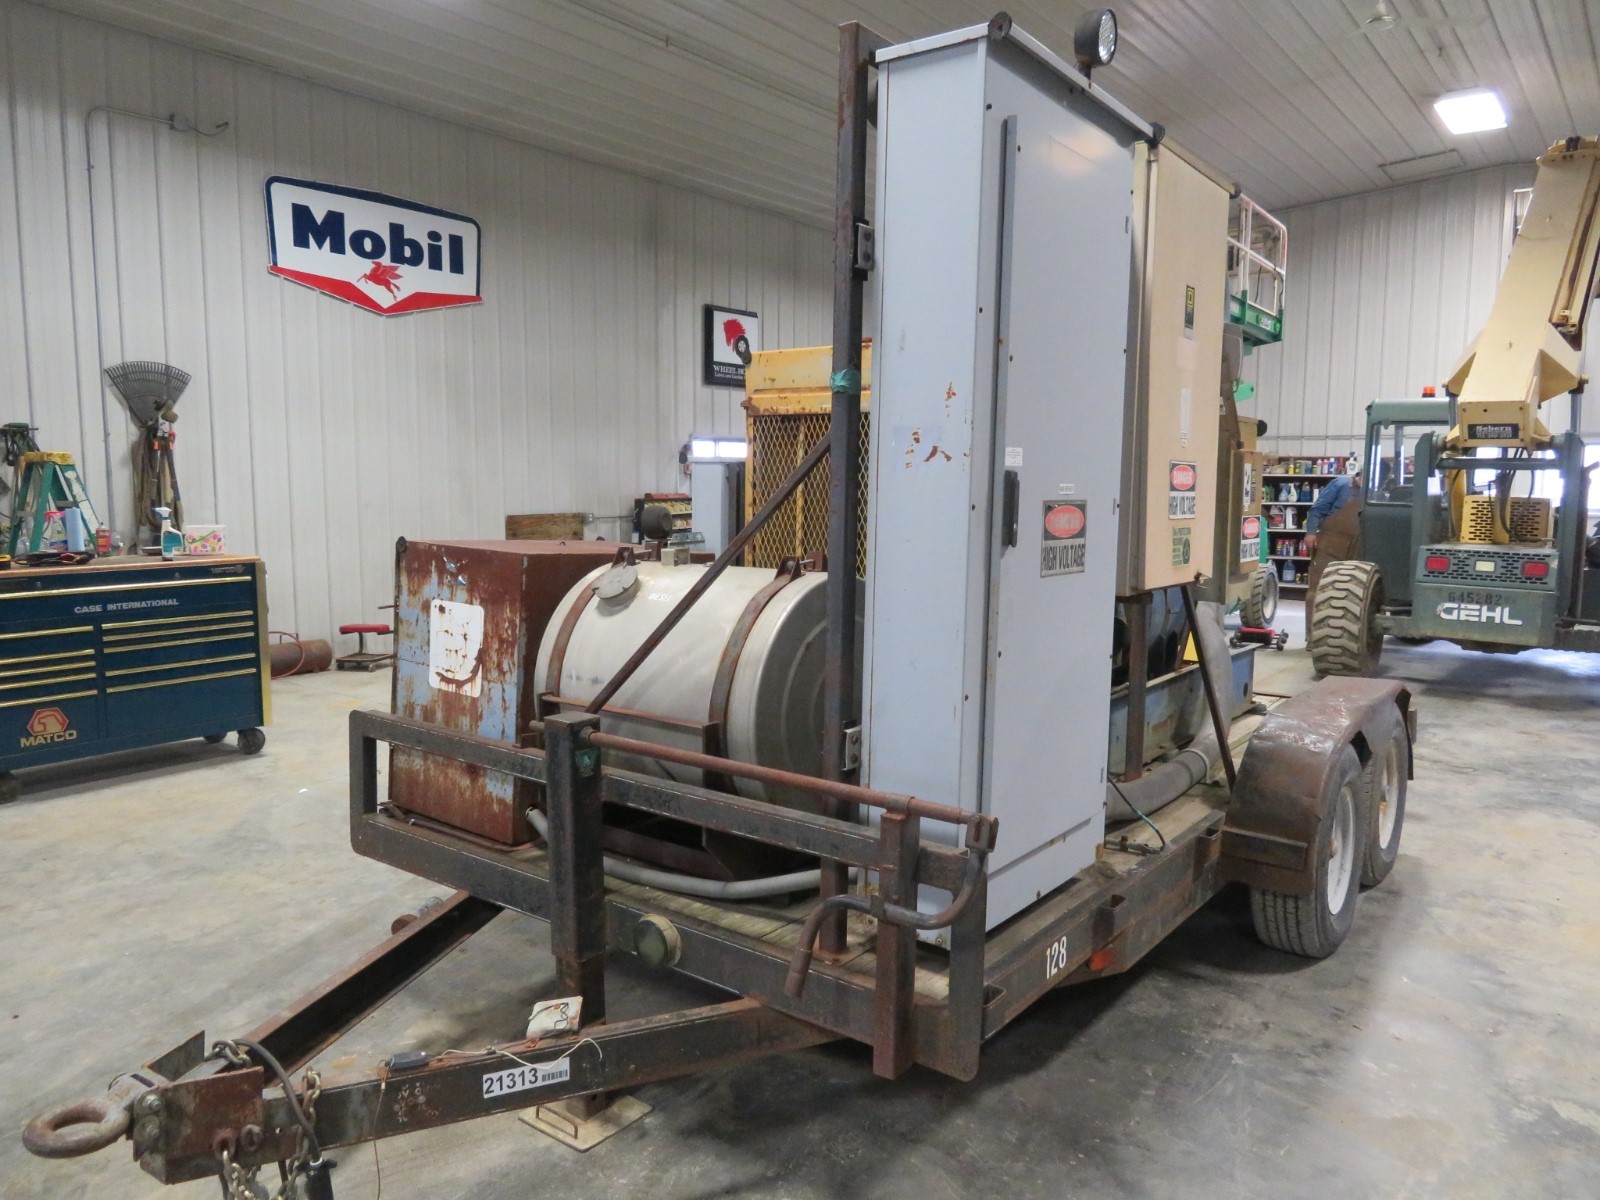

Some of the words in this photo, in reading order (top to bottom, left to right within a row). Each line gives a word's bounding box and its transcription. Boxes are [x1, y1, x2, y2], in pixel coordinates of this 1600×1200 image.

[291, 202, 464, 275] Mobil
[713, 365, 737, 374] WHEEL
[1173, 470, 1192, 485] DANGER
[1169, 495, 1178, 515] HIGH
[1179, 495, 1196, 515] VOLTAGE
[1041, 545, 1057, 571] HIGH
[1058, 543, 1086, 570] VOLTAGE
[74, 604, 102, 614] CASE
[107, 598, 179, 611] INTERNATIONAL
[1436, 602, 1523, 626] GEHL
[20, 729, 77, 748] MATCO
[1045, 935, 1067, 980] 128
[484, 1067, 539, 1095] 21313
